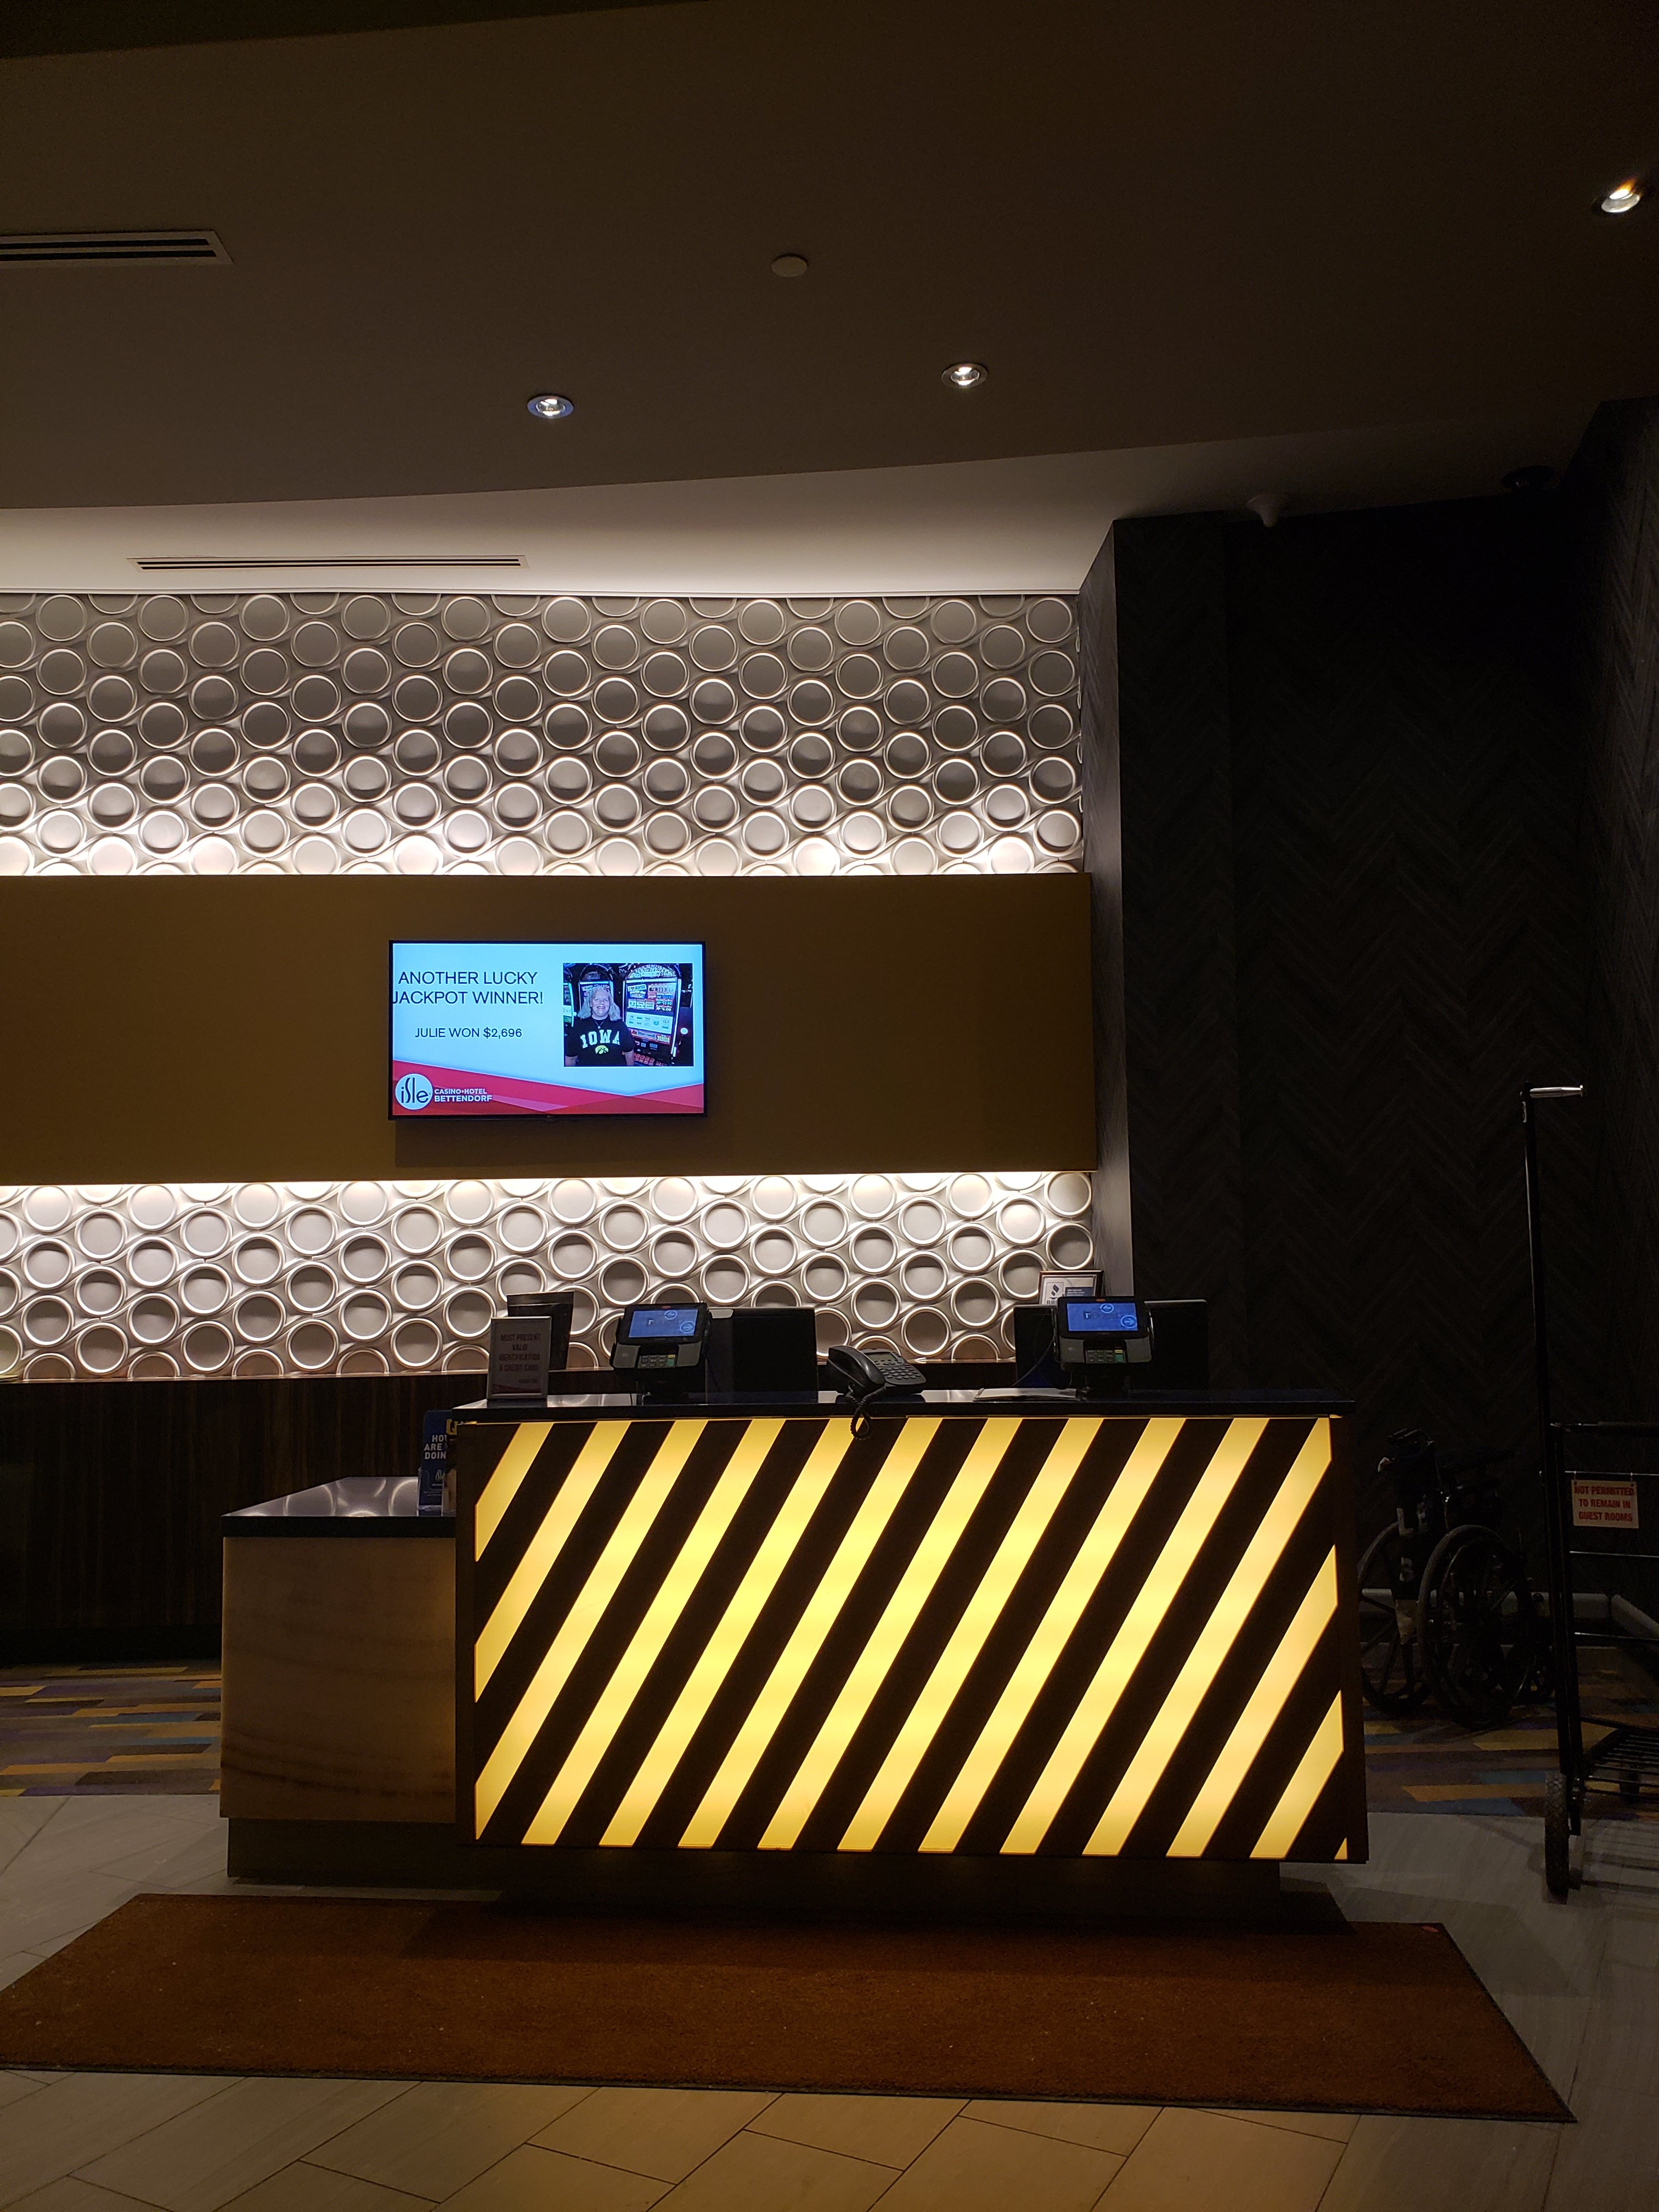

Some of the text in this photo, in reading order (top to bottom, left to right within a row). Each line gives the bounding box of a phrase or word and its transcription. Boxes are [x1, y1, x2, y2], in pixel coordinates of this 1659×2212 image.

[398, 971, 538, 985] ANOTHER LUCKY
[392, 991, 543, 1004] JACKPOT WINNER!
[415, 1026, 522, 1039] JULIE WON $2,696
[580, 1029, 621, 1049] IOWA
[1574, 1486, 1634, 1496] NOT PERMITTED
[1578, 1498, 1630, 1509] TO REMAIN IN
[1578, 1511, 1633, 1521] GUEST ROOMS
